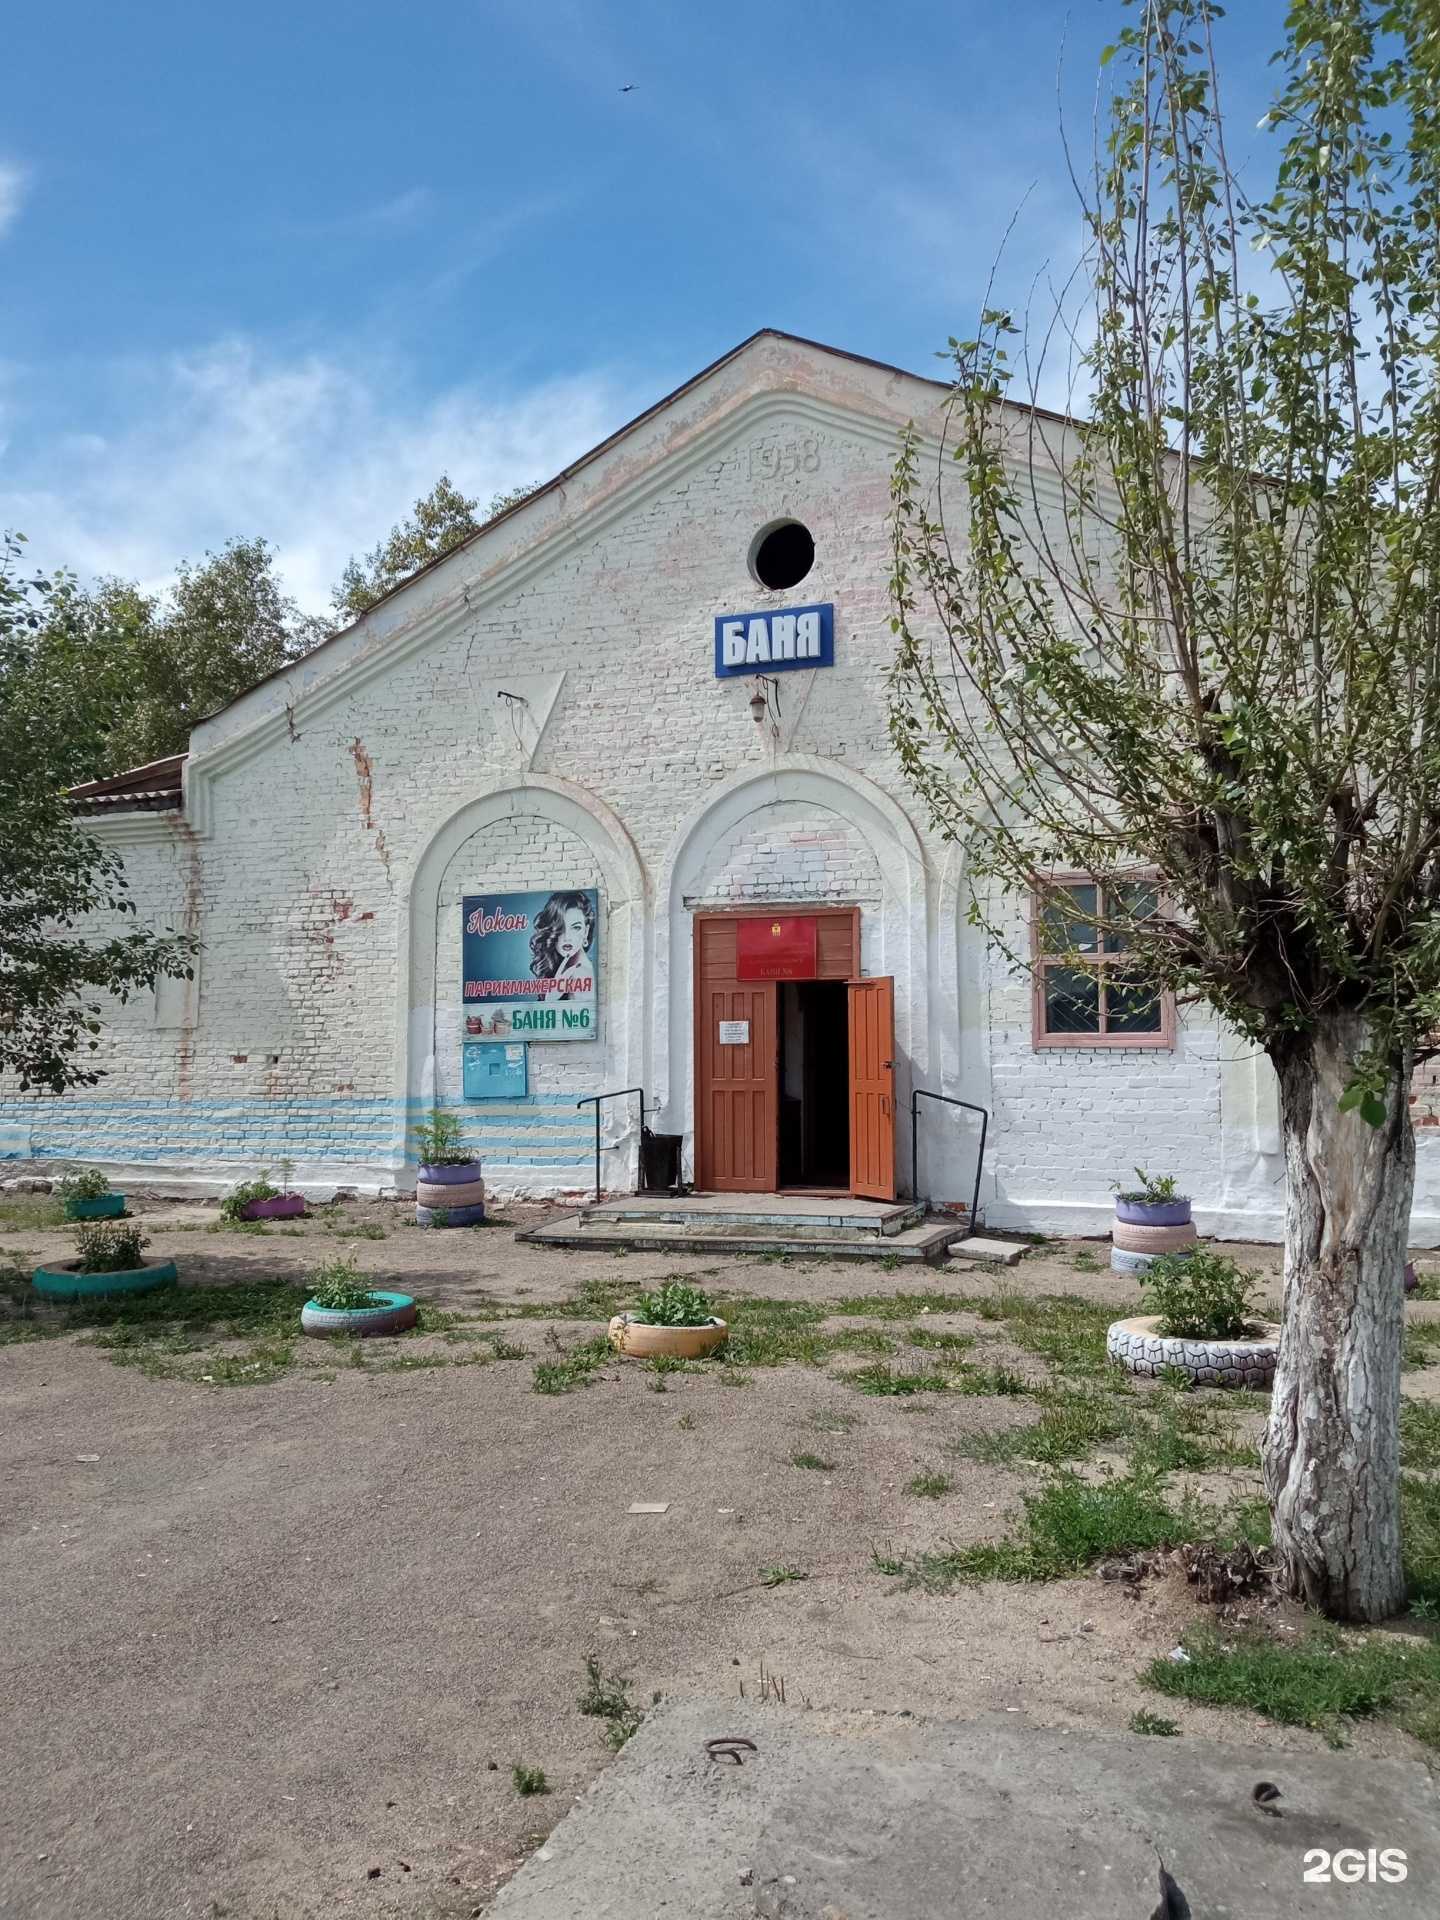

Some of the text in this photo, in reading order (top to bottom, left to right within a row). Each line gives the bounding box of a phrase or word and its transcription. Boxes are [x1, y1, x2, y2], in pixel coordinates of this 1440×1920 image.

[722, 611, 821, 667] БАНЯ
[467, 907, 527, 936] Локон
[465, 978, 592, 996] ПАРИКМАХЕРСКАЯ
[512, 1008, 590, 1030] БАНЯ №6
